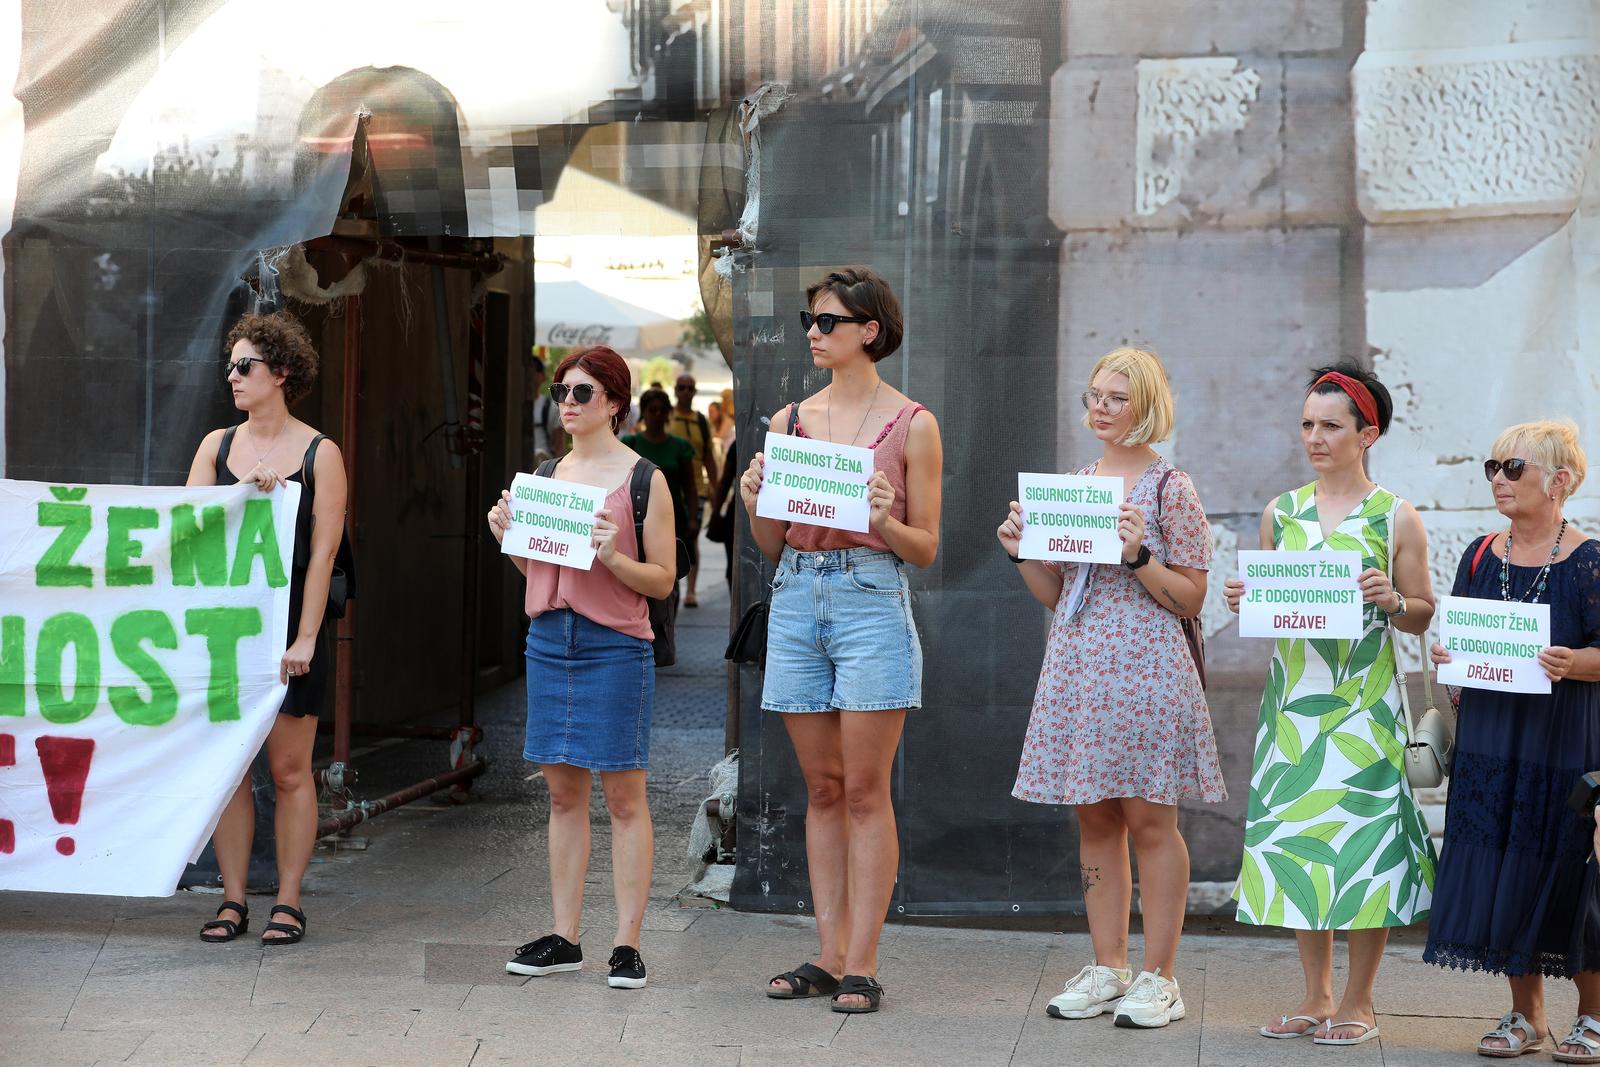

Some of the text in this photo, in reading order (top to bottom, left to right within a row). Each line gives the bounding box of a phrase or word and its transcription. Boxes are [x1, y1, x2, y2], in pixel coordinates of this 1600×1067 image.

[771, 446, 863, 474] SIGURNOST ŽENA
[768, 471, 866, 499] JE ODGOVORNOST
[1025, 485, 1113, 505] SIGURNOST ŽENA
[515, 485, 594, 513] SIGURNOST ŽENA
[788, 498, 836, 520] DRŽAVE!
[512, 510, 524, 523] JE
[1026, 512, 1118, 530] JE ODGOVORNOST
[35, 485, 288, 588] ŽENA
[528, 535, 569, 557] DRŽAVE!
[1048, 535, 1093, 554] DRŽAVE!
[1247, 560, 1351, 578] SIGURNOST ŽENA
[1247, 589, 1356, 604] JE ODGOVORNOST
[1273, 611, 1326, 629] DRŽAVE!
[1446, 610, 1539, 632] SIGURNOST ŽENA
[1445, 636, 1458, 651] JE
[1467, 662, 1513, 683] DRŽAVE!
